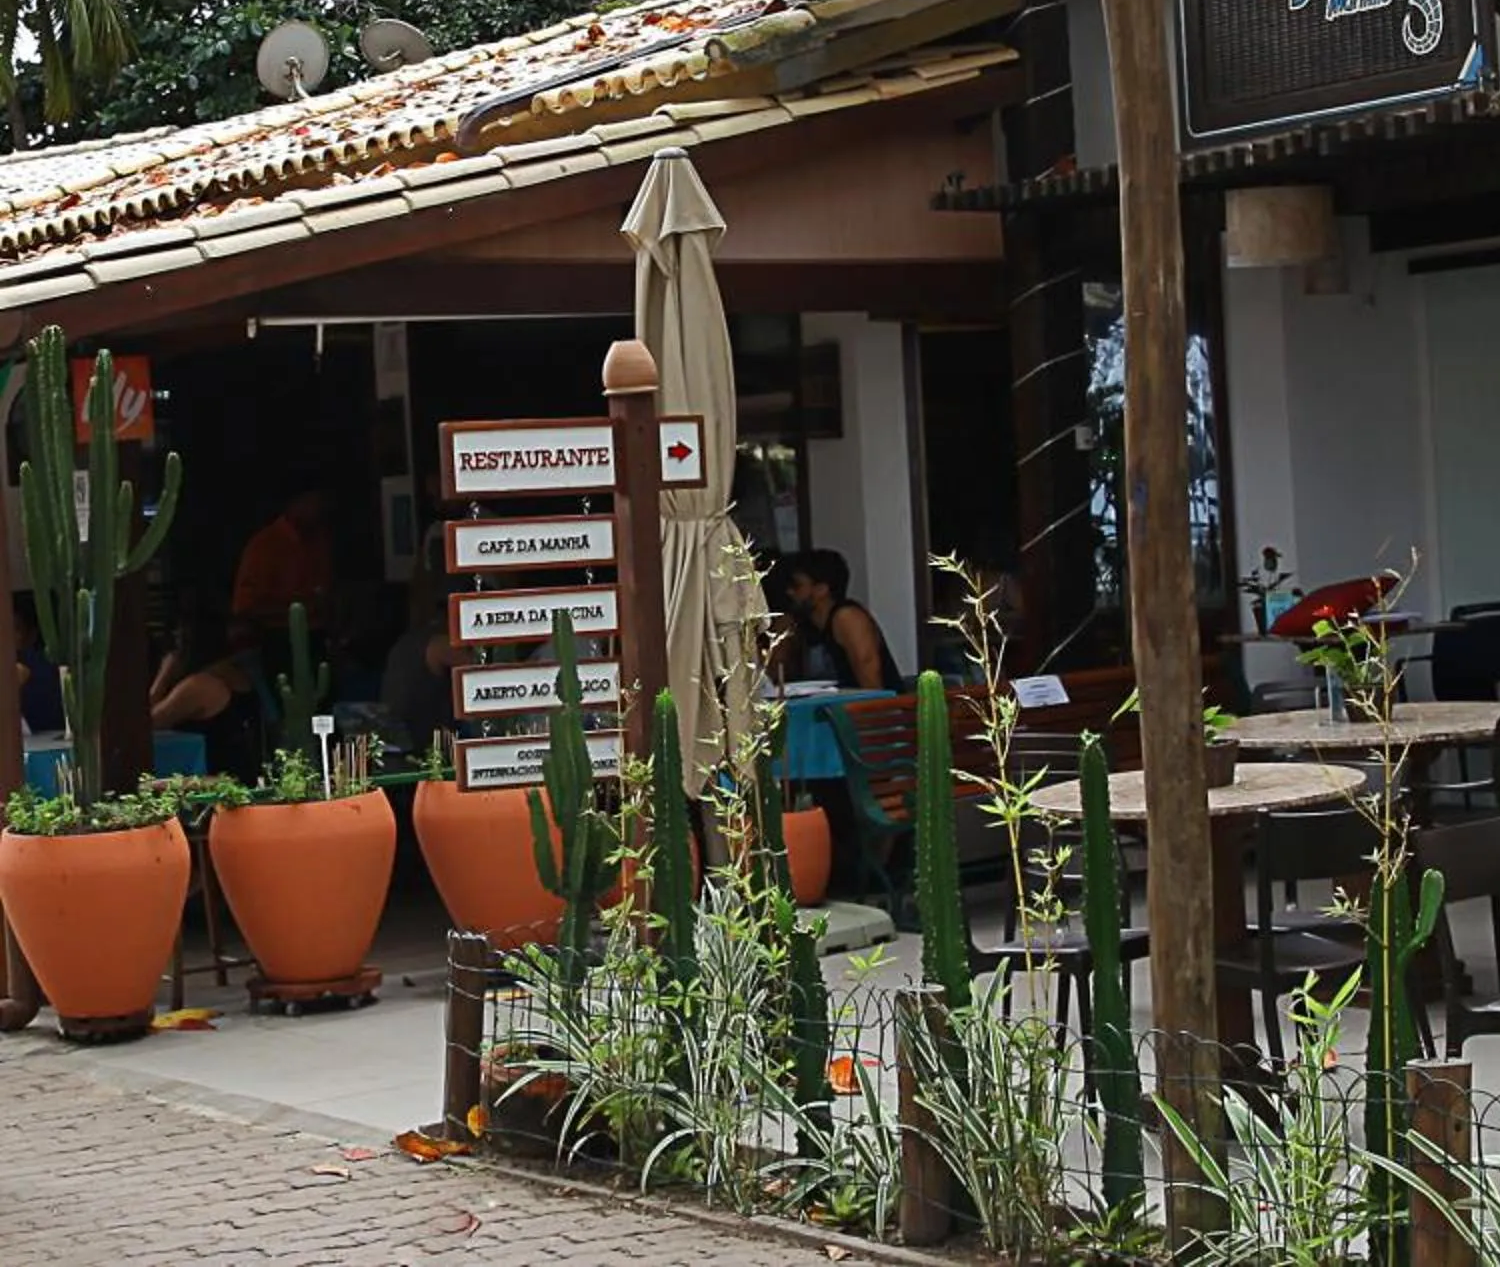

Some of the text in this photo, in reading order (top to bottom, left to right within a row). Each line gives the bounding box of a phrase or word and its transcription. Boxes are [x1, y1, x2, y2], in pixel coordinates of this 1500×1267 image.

[459, 446, 610, 471] RESTAURANTE
[478, 537, 514, 554] CAFÉ
[517, 538, 537, 553] DA
[486, 610, 525, 625] BEIRA
[528, 608, 548, 622] DA
[474, 682, 551, 701] ABERTO AO
